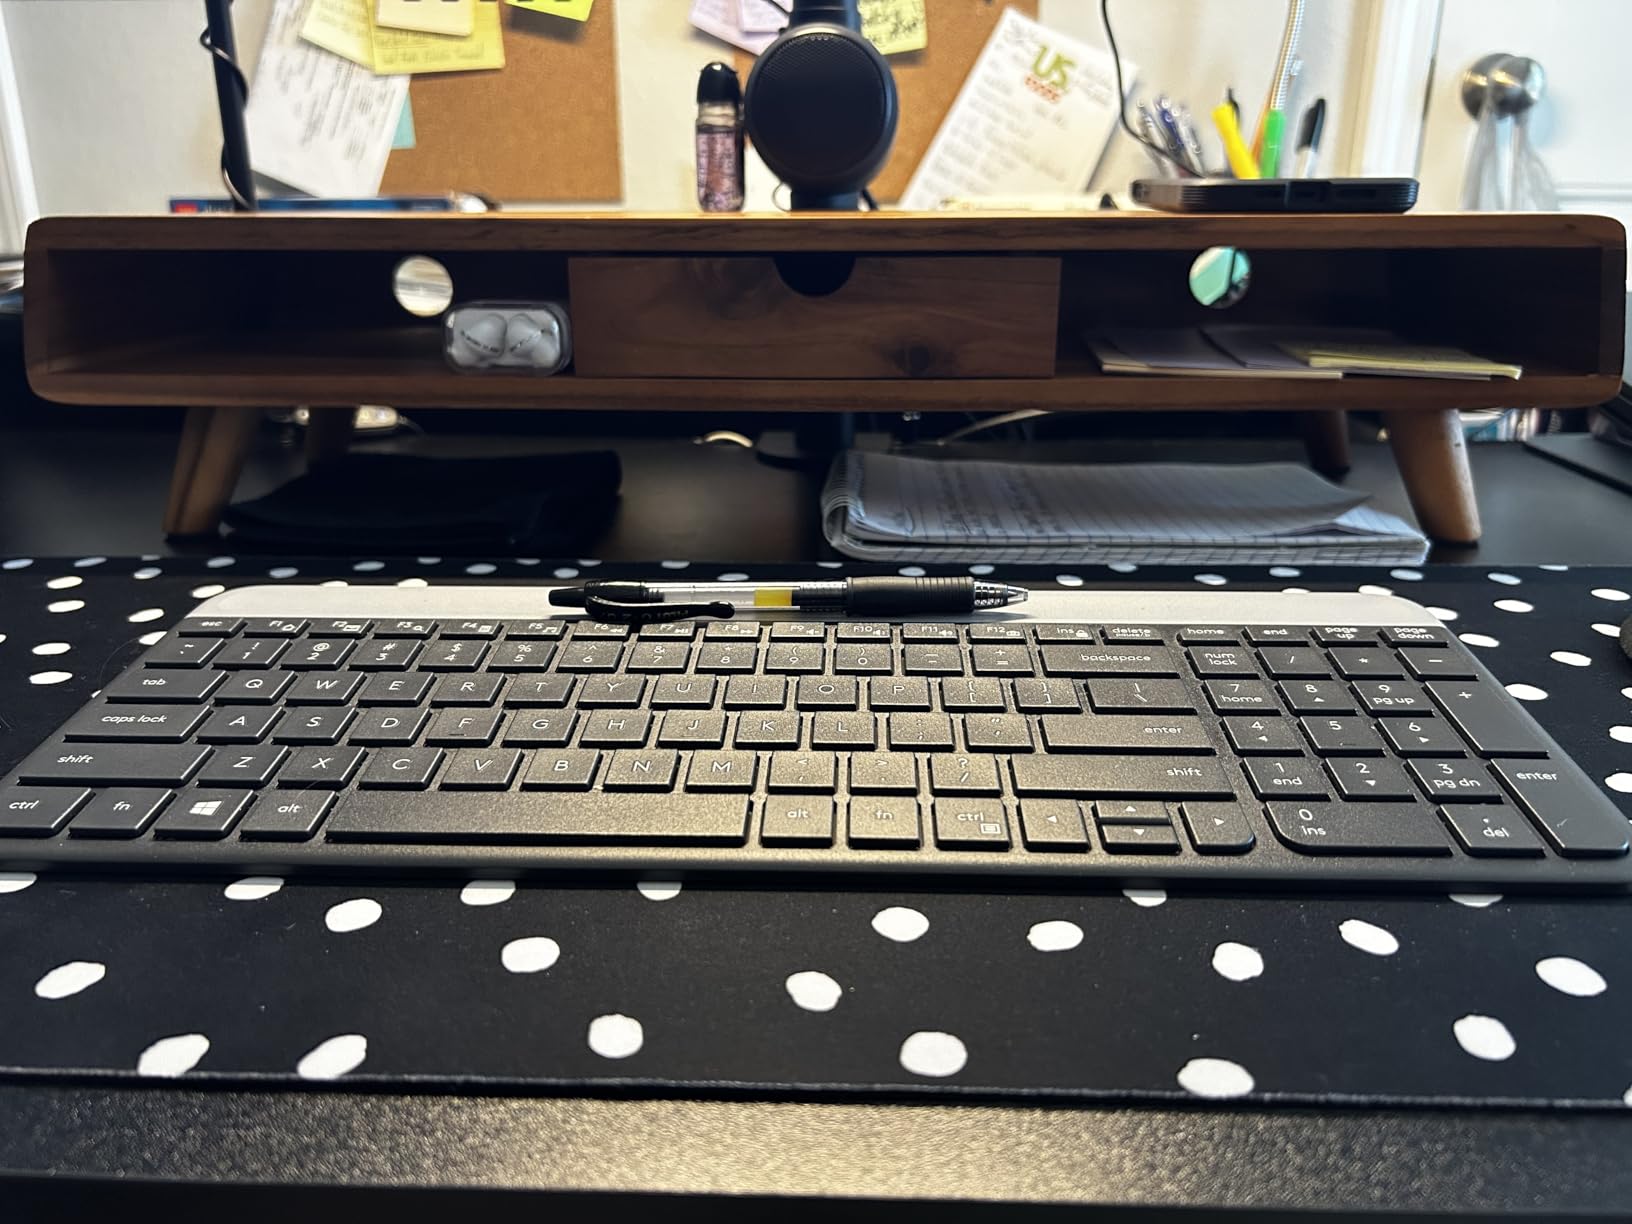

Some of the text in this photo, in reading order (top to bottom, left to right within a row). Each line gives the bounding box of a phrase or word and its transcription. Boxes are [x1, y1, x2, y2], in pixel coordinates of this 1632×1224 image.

[853, 625, 873, 633] F10
[1324, 626, 1358, 634] page
[1393, 627, 1428, 635] page
[1398, 632, 1435, 640] down
[313, 642, 330, 652] @
[376, 653, 388, 661] 3
[444, 654, 455, 662] 4
[514, 654, 525, 662] 5
[583, 655, 593, 663] 6
[720, 656, 730, 664] 8
[789, 656, 799, 664] 9
[1081, 654, 1151, 662] backspace
[1209, 658, 1238, 666] lock
[142, 678, 167, 686] tab
[245, 679, 264, 689] Q
[316, 680, 339, 690] W
[388, 681, 405, 690] E
[460, 682, 476, 691] R
[535, 682, 548, 692] T
[607, 683, 620, 692] Y
[676, 684, 691, 692] U
[818, 684, 835, 693] O
[893, 685, 905, 695] P
[1229, 684, 1240, 692] 7
[1305, 684, 1317, 693] 8
[1378, 684, 1390, 693] 9
[1221, 695, 1263, 703] home
[1373, 696, 1415, 705] pg up
[101, 715, 167, 724] caps lock
[229, 716, 246, 726] A
[306, 716, 322, 727] S
[381, 717, 399, 728] D
[458, 718, 474, 728] F
[532, 719, 550, 729] G
[607, 719, 626, 730] H
[688, 720, 699, 730] J
[761, 721, 775, 731] K
[838, 722, 848, 732] L
[1252, 721, 1264, 730] 4
[1329, 721, 1341, 730] 5
[1408, 722, 1421, 732] 6
[1144, 726, 1183, 734] enter
[57, 755, 94, 764] shift
[233, 757, 254, 768] Z
[311, 758, 332, 769] X
[392, 759, 411, 770] C
[474, 760, 493, 771] V
[554, 760, 569, 771] B
[632, 761, 650, 772] N
[712, 761, 732, 773] M
[1275, 763, 1285, 773] 1
[1356, 763, 1370, 773] 2
[1437, 763, 1454, 774] 3
[1166, 768, 1203, 776] shift
[1516, 772, 1558, 781] enter
[1273, 777, 1303, 785] end
[1433, 778, 1481, 788] pg dn
[9, 800, 39, 809] ctrl
[113, 802, 131, 811] fn
[277, 803, 301, 814] alt
[787, 809, 809, 819] alt
[875, 810, 893, 820] fn
[957, 812, 984, 821] ctrl
[1299, 809, 1313, 821] 0
[1300, 826, 1326, 836] ins
[1483, 827, 1510, 838] del
